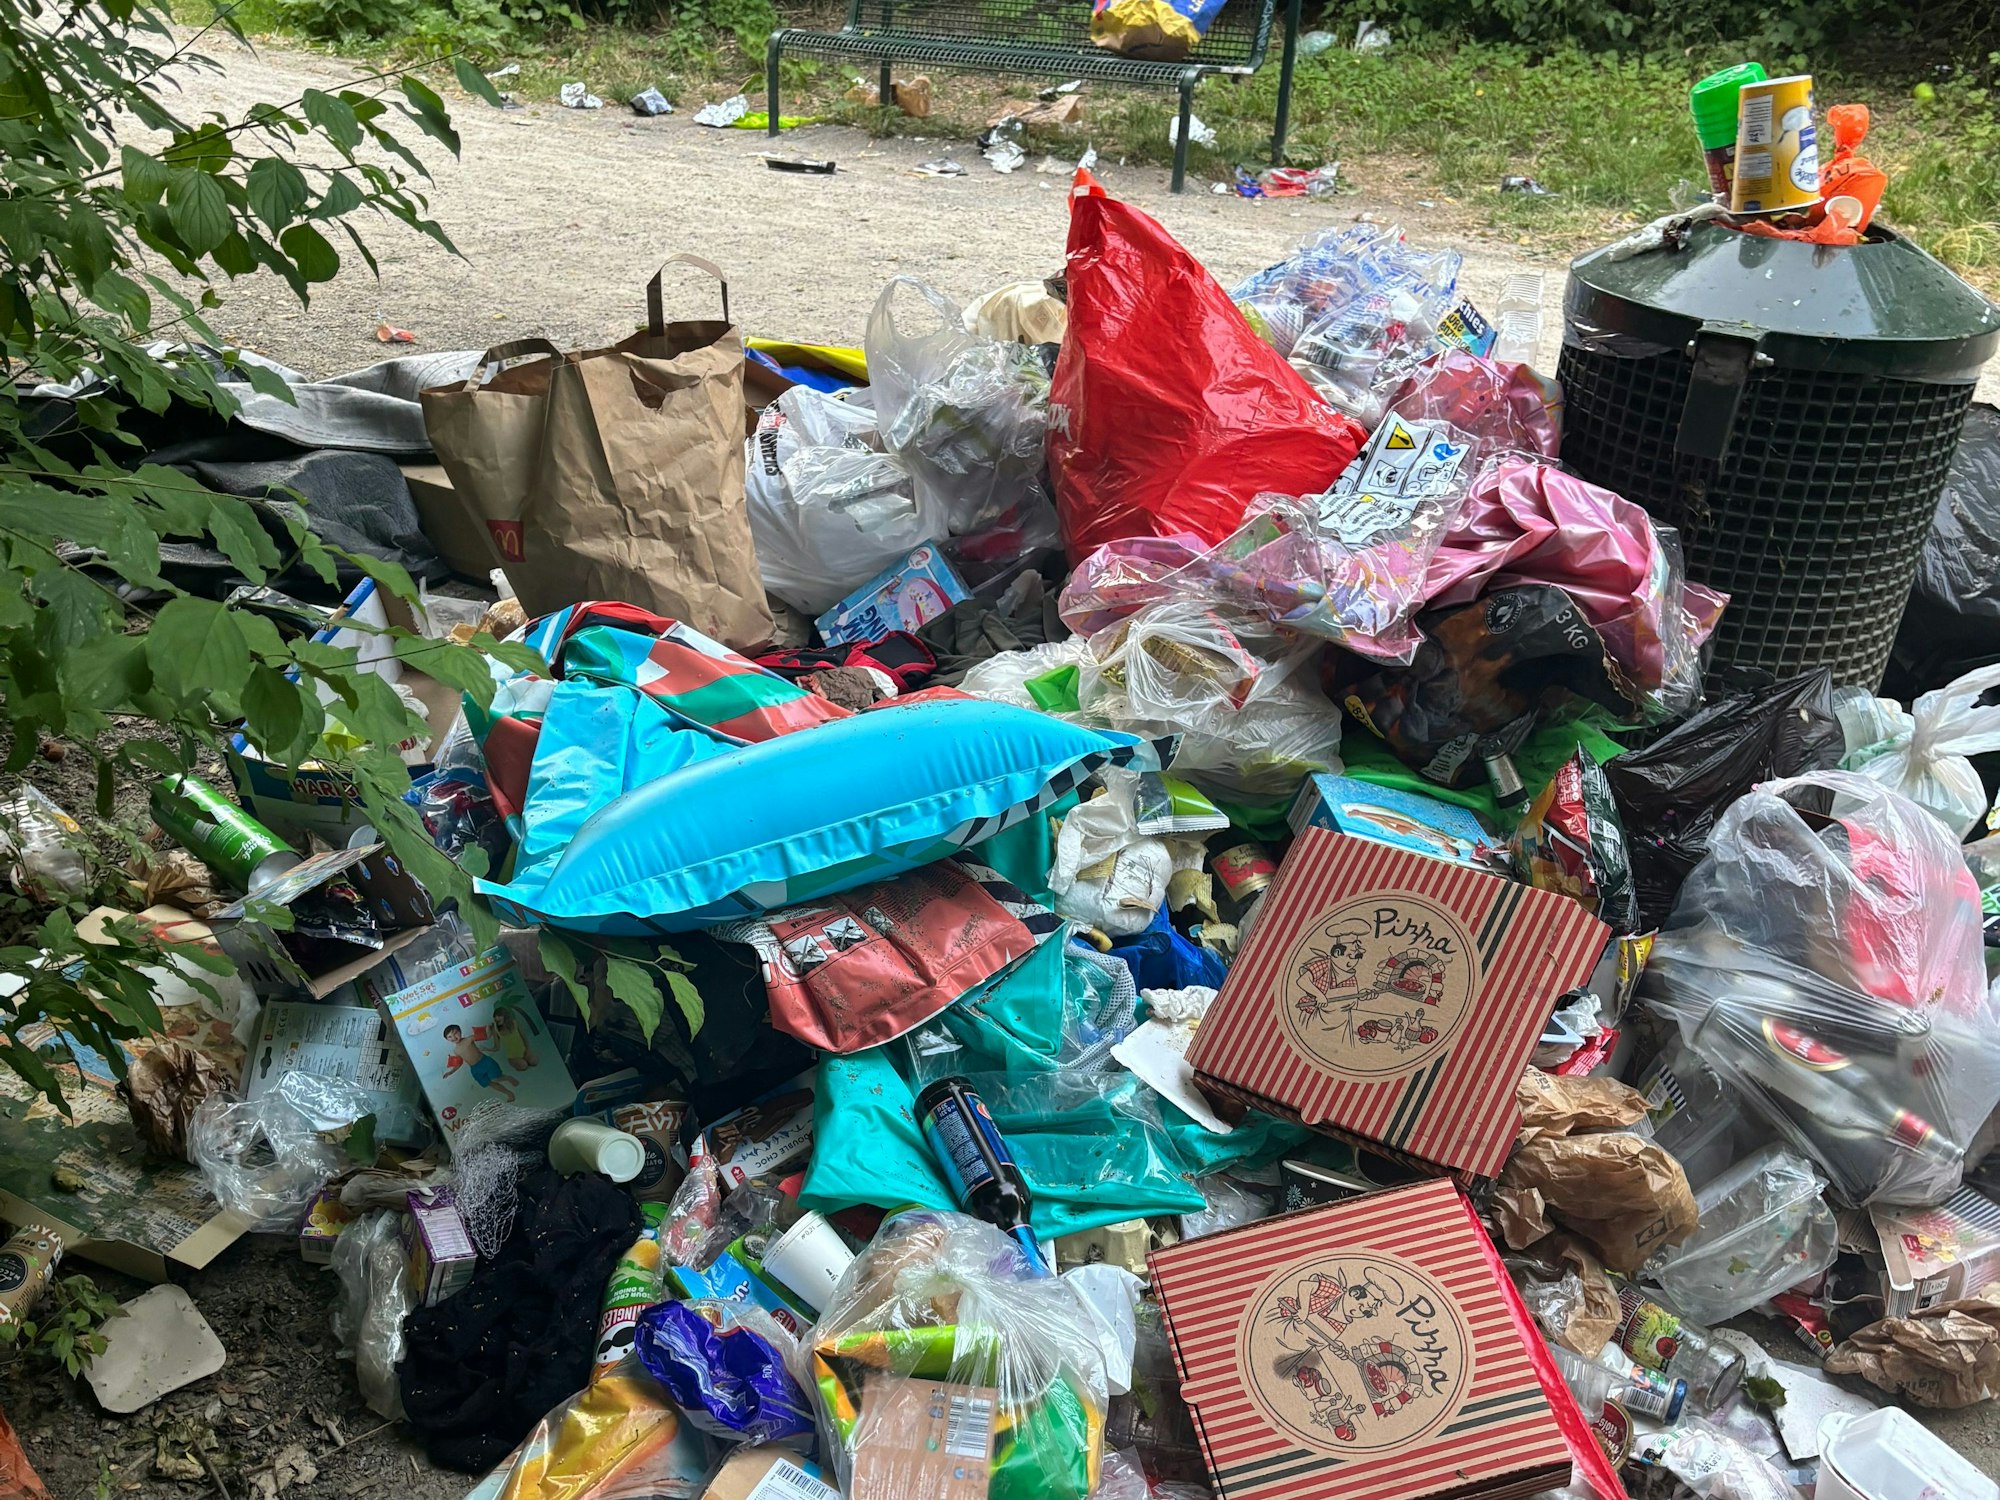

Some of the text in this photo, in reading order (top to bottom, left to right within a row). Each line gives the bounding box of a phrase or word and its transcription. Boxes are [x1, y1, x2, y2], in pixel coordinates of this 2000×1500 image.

[860, 604, 890, 643] ING
[1556, 609, 1589, 649] 3 KG
[1373, 907, 1456, 955] Pizza
[460, 952, 503, 976] INTEX
[459, 974, 514, 1007] INTEX
[755, 1151, 780, 1169] CHOC
[613, 1286, 638, 1296] ONION
[600, 1304, 646, 1334] INGLES
[1395, 1294, 1453, 1396] Pizza
